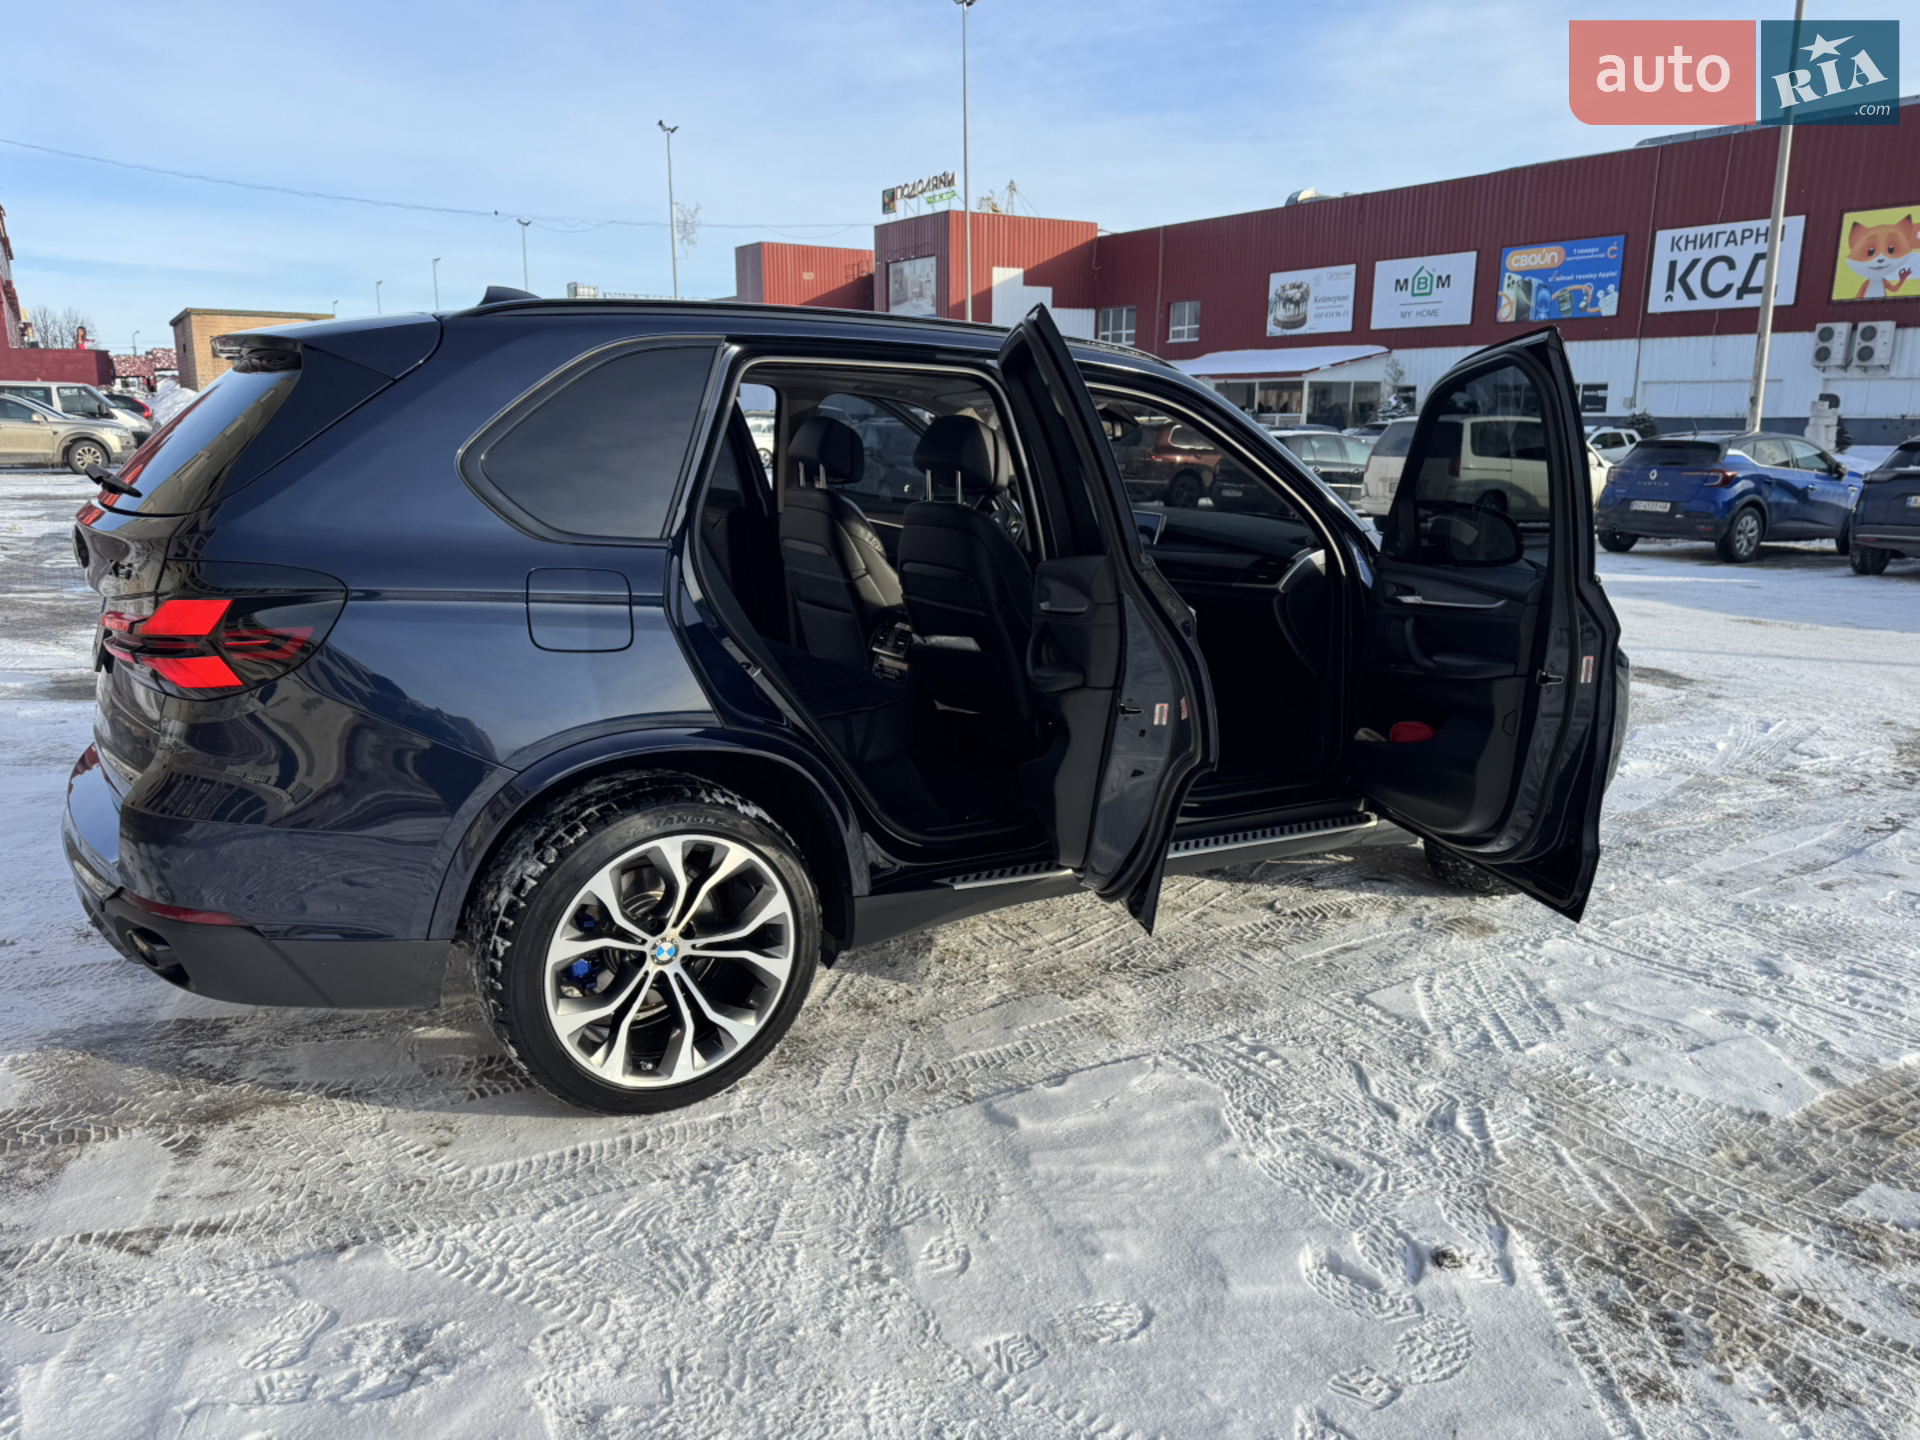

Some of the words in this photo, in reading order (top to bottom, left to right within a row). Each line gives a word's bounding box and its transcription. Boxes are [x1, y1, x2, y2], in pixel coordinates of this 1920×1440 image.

[1670, 225, 1785, 252] КНИГАРН
[1664, 252, 1777, 303] КСД
[1400, 310, 1412, 318] MY
[1415, 308, 1440, 318] HOME
